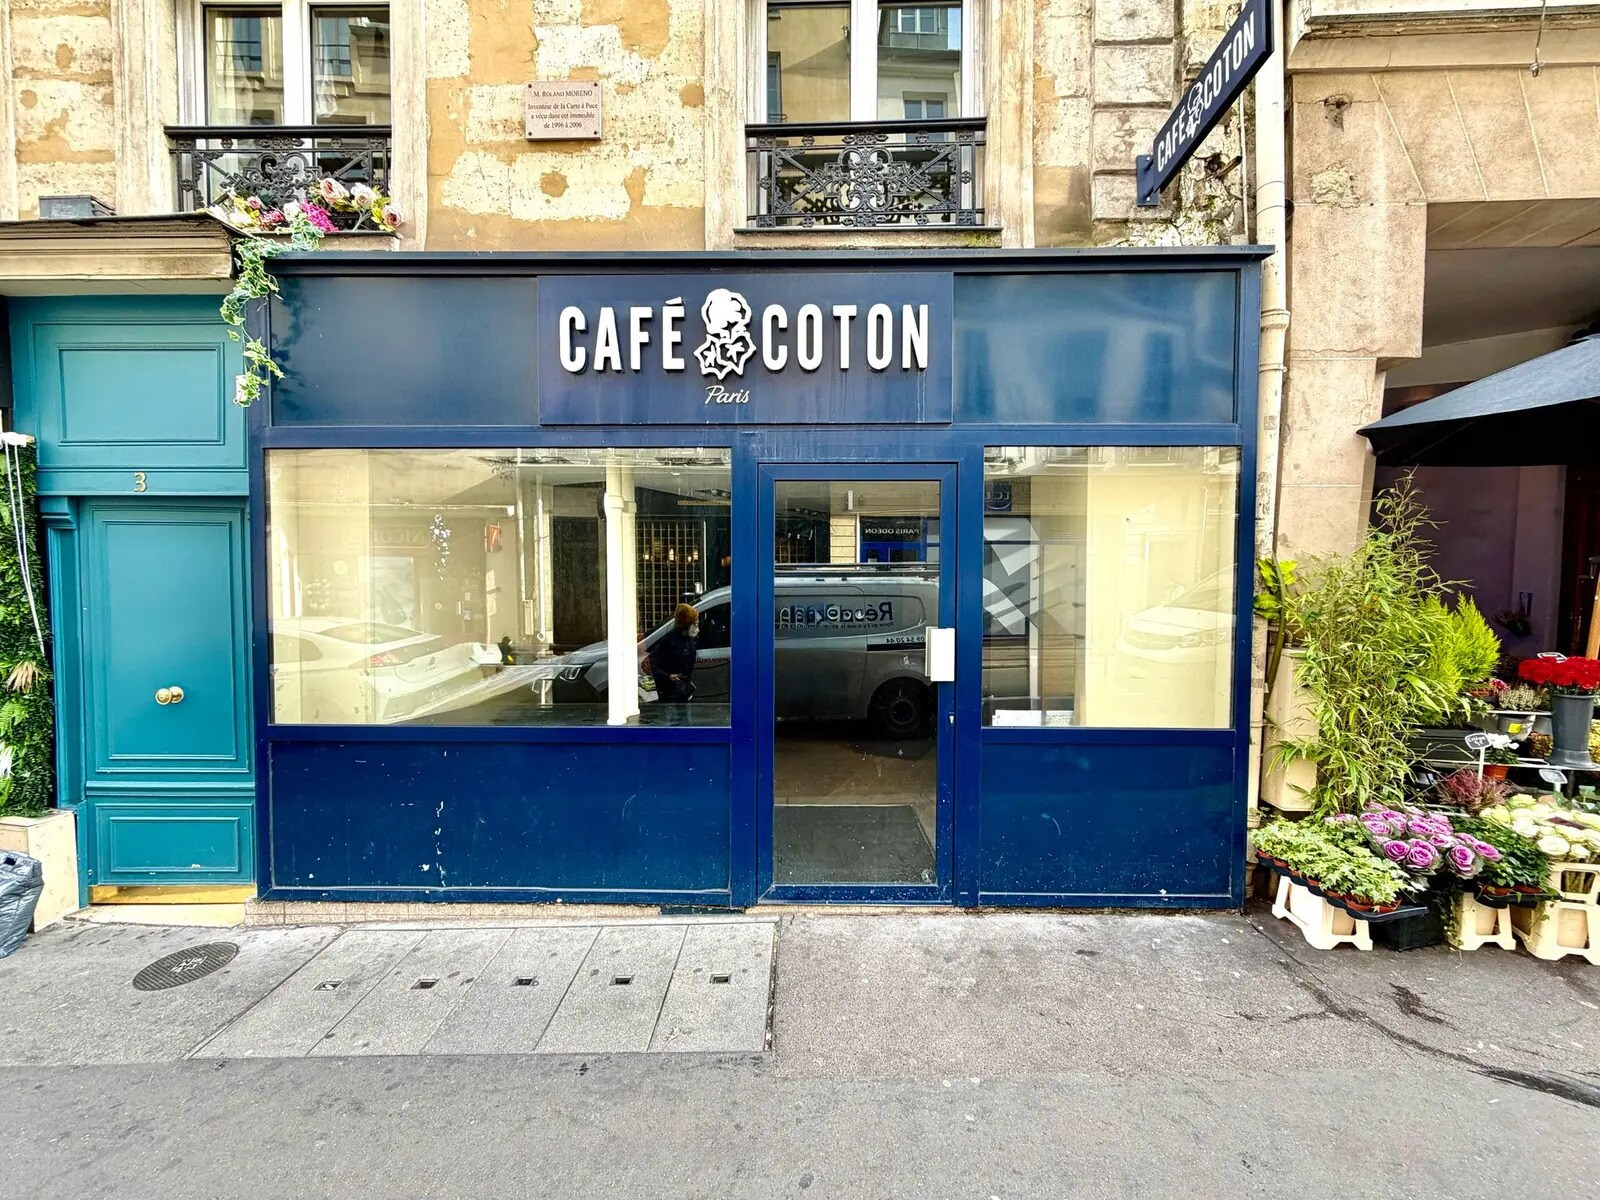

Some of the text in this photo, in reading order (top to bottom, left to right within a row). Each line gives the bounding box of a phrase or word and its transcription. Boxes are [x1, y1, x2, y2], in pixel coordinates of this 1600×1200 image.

[1157, 11, 1255, 172] CAFÉ COTON
[559, 296, 929, 373] CAFÉ COTON
[704, 384, 750, 405] Paris
[134, 472, 148, 492] 3
